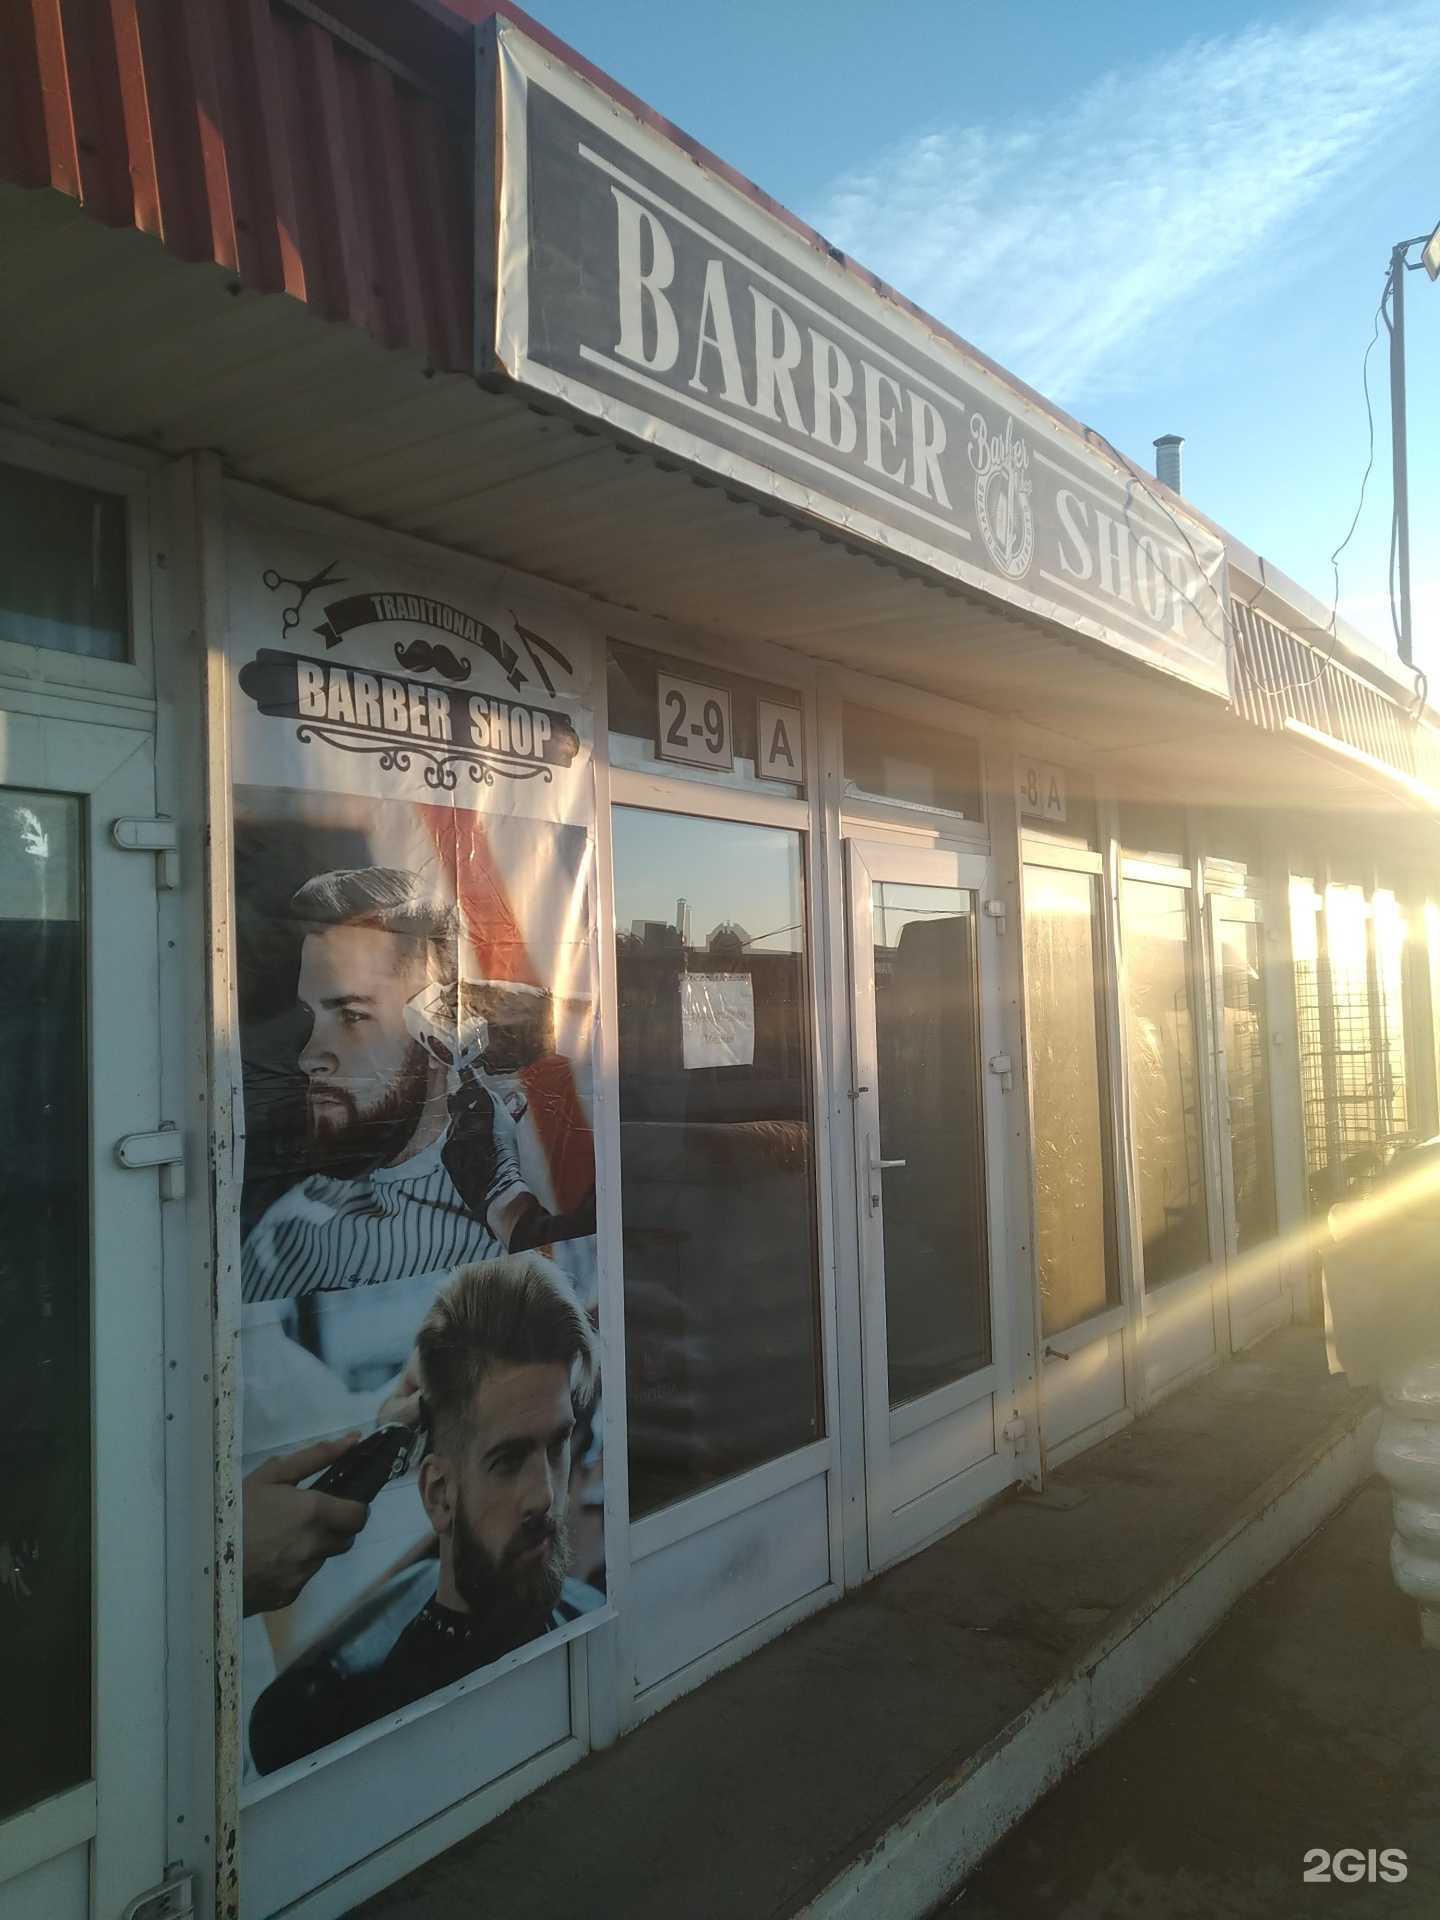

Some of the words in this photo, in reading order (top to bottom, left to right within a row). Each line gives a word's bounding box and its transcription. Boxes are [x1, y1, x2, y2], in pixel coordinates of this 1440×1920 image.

[611, 184, 953, 510] BARBER
[1056, 489, 1194, 641] SHOP
[370, 595, 488, 647] TRADITIONAL
[297, 660, 453, 741] BARBER
[469, 696, 552, 759] SHOP
[665, 690, 725, 754] 2-9
[769, 719, 795, 767] A
